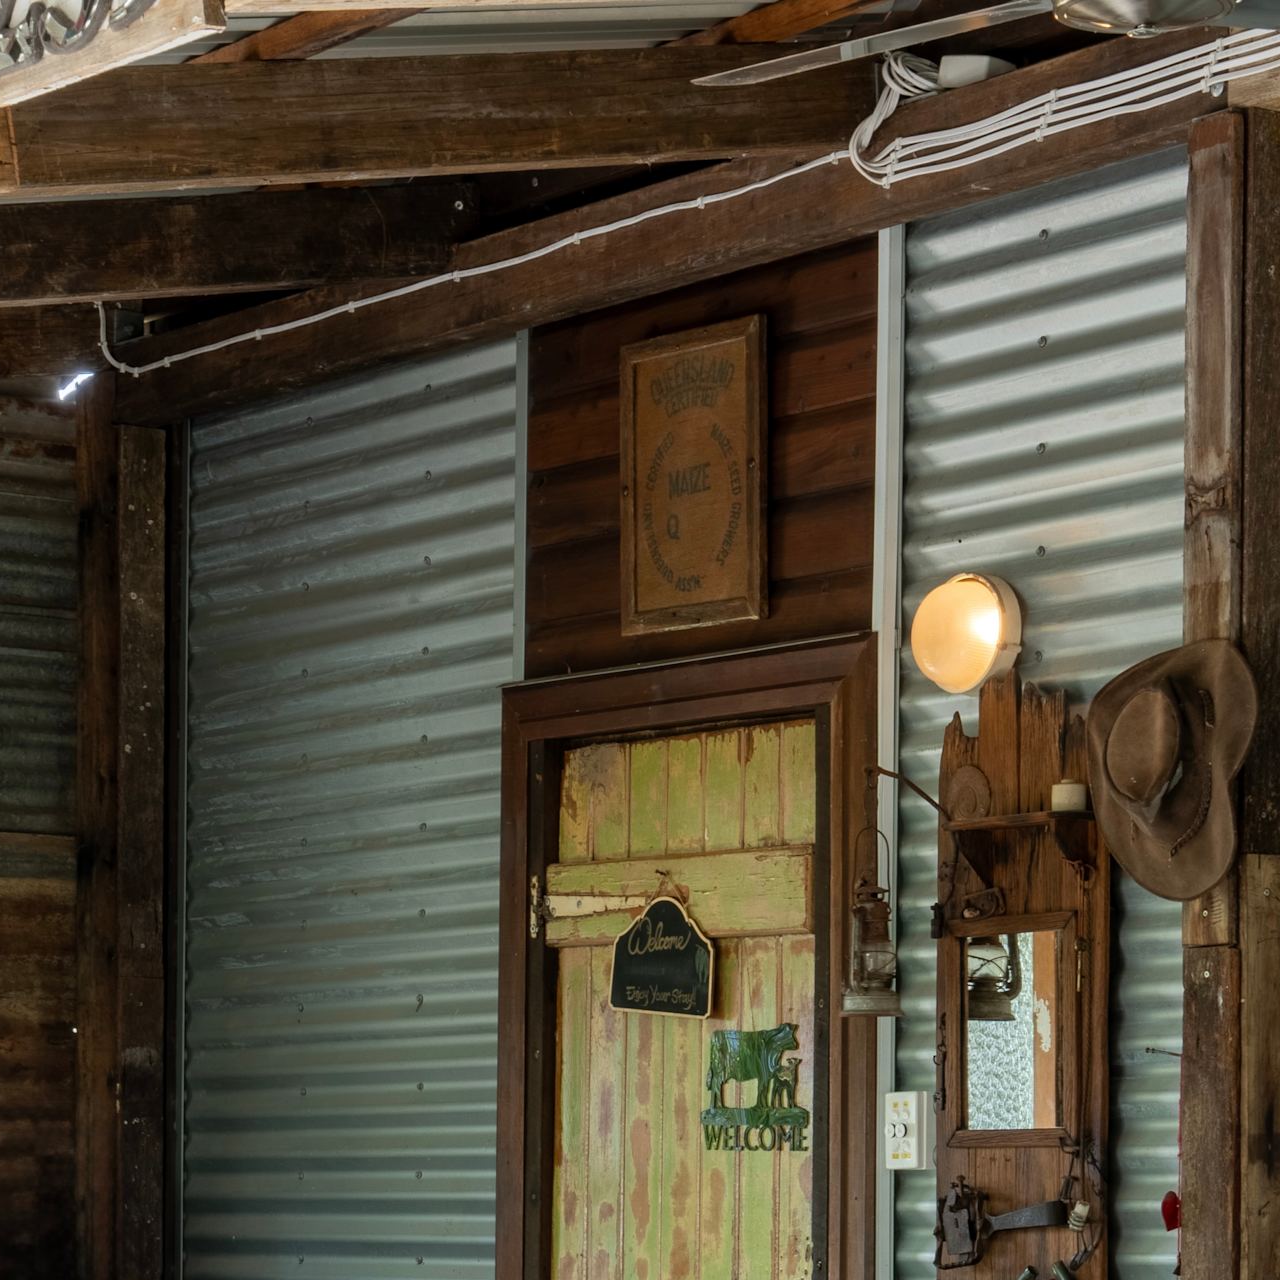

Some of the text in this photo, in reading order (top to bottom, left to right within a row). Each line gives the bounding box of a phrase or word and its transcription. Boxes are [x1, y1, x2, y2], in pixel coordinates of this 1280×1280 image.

[650, 352, 735, 405] QUEENSLAND
[665, 388, 719, 418] CERTIFIED
[710, 422, 734, 458] MAIZE
[646, 432, 674, 492] CERTIFIED
[728, 460, 742, 495] SEED
[668, 461, 711, 500] MAIZE
[666, 514, 680, 540] Q
[715, 501, 742, 566] GROWERS
[627, 916, 692, 956] Welcome
[626, 985, 649, 1007] Enjoy
[649, 983, 671, 1004] Your
[704, 1125, 809, 1152] WELCOME
